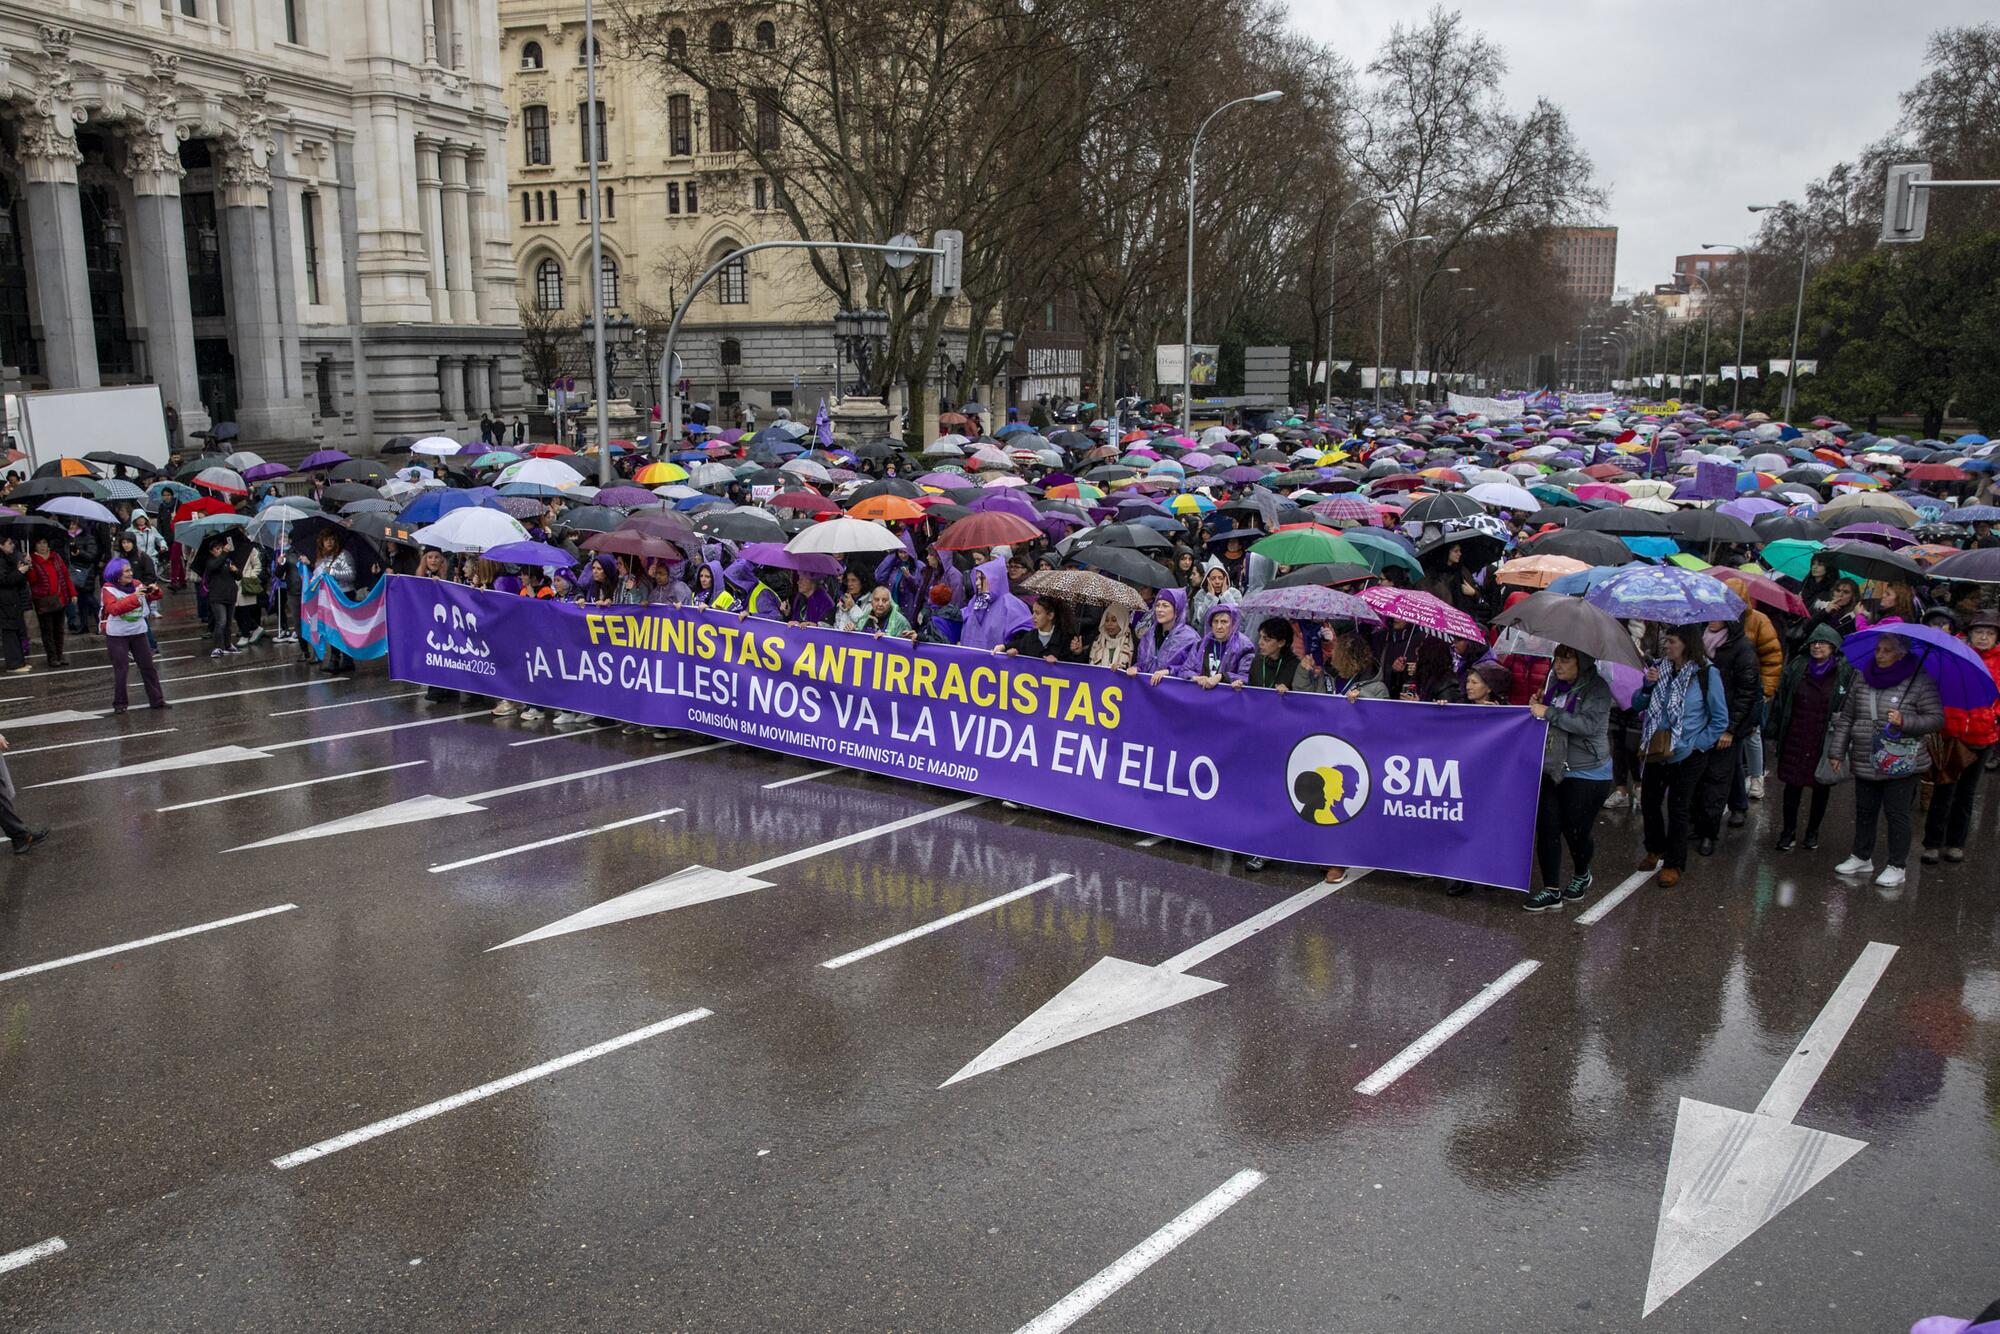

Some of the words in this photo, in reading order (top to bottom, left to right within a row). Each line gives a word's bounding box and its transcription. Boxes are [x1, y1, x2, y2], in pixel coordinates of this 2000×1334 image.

[425, 652, 443, 667] 8M
[586, 614, 785, 671] FEMINISTAS
[793, 643, 1122, 728] ANTIRRACISTAS
[525, 647, 553, 682] ¡A
[556, 649, 614, 686] LAS
[619, 655, 738, 707] CALLES!
[748, 675, 822, 723] NOS
[829, 691, 880, 736] VA
[890, 702, 937, 747] LA
[949, 711, 1039, 767] VIDA
[1050, 730, 1108, 780] EN
[1117, 742, 1220, 801] ELLO
[687, 708, 739, 732] COMISIÓN
[740, 720, 757, 736] 8M
[759, 724, 837, 753] MOVIMIENTO
[839, 740, 906, 768] FEMINISTA
[907, 755, 926, 772] DE
[927, 759, 979, 782] MADRID
[1382, 754, 1463, 799] 8M
[1382, 798, 1464, 822] Madrid
